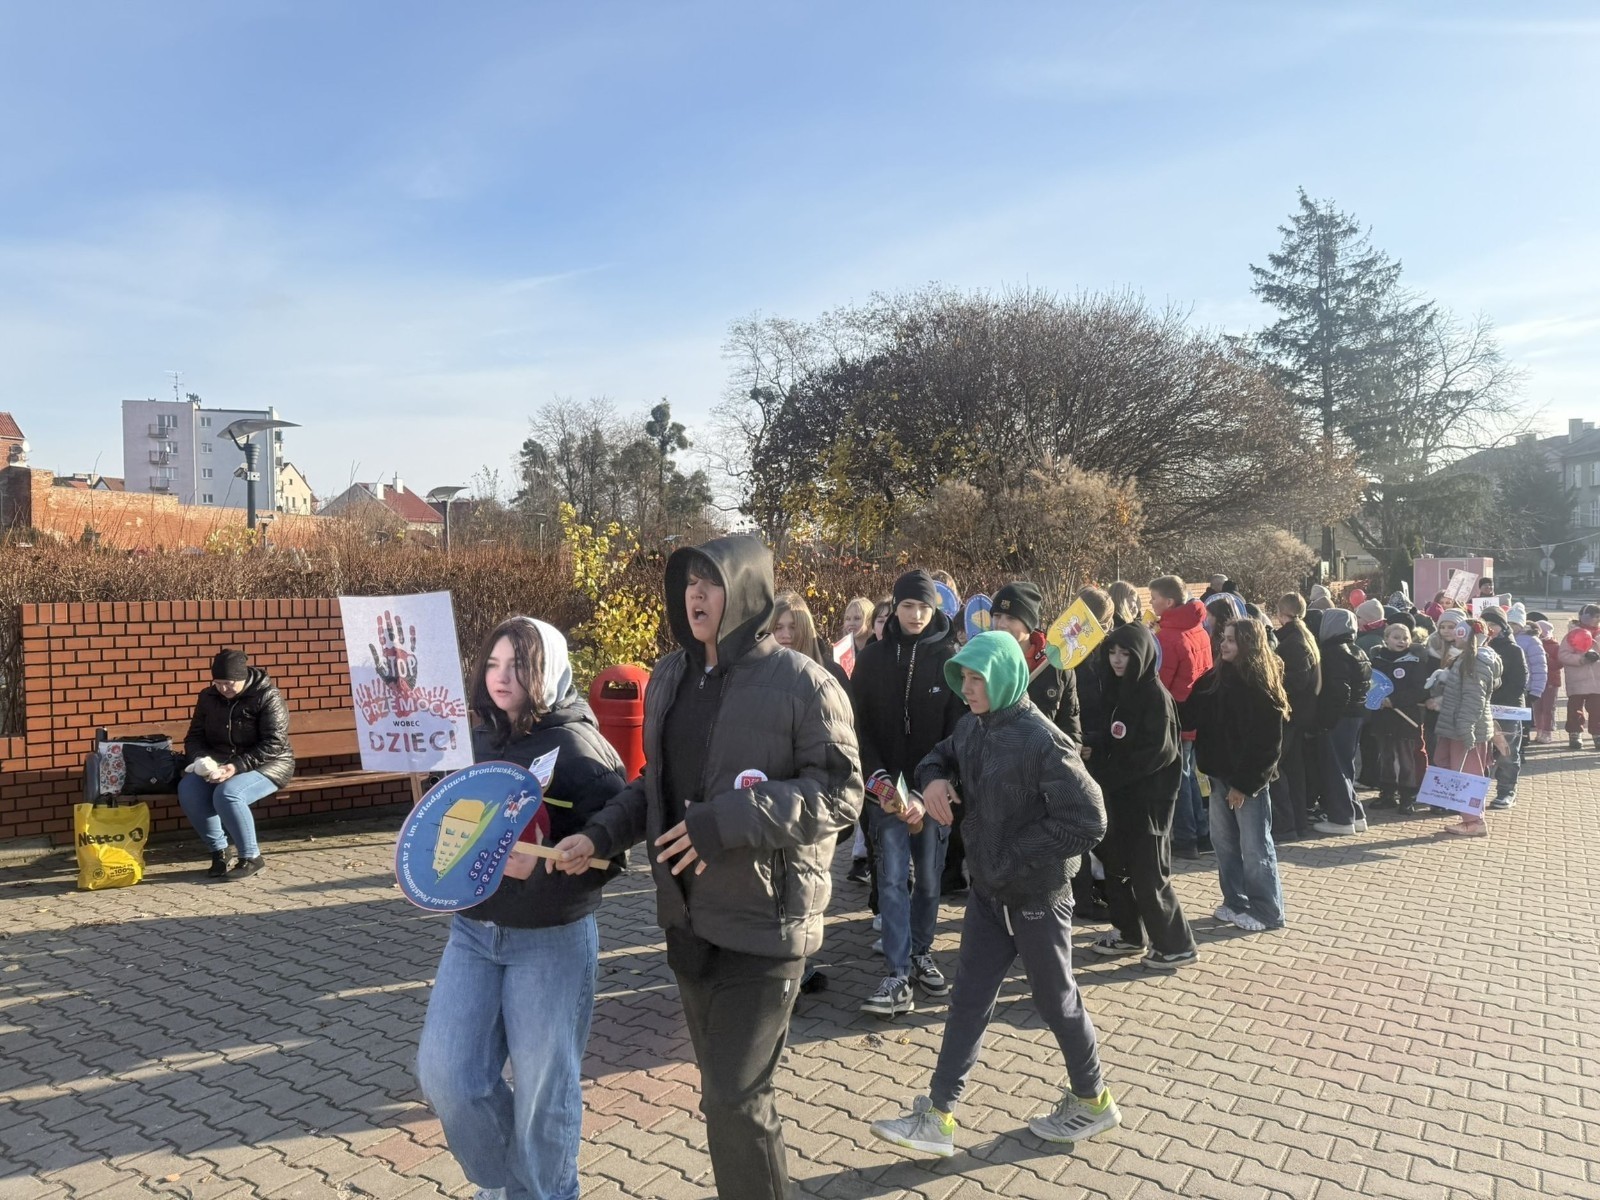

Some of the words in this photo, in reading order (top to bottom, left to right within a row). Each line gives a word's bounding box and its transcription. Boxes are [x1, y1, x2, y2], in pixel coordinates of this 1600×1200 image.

[378, 655, 416, 678] STOP
[369, 730, 457, 753] DZIECI
[403, 851, 409, 861] nr
[468, 765, 525, 781] Broniewskiego
[79, 832, 125, 847] Netto
[480, 851, 488, 859] 2
